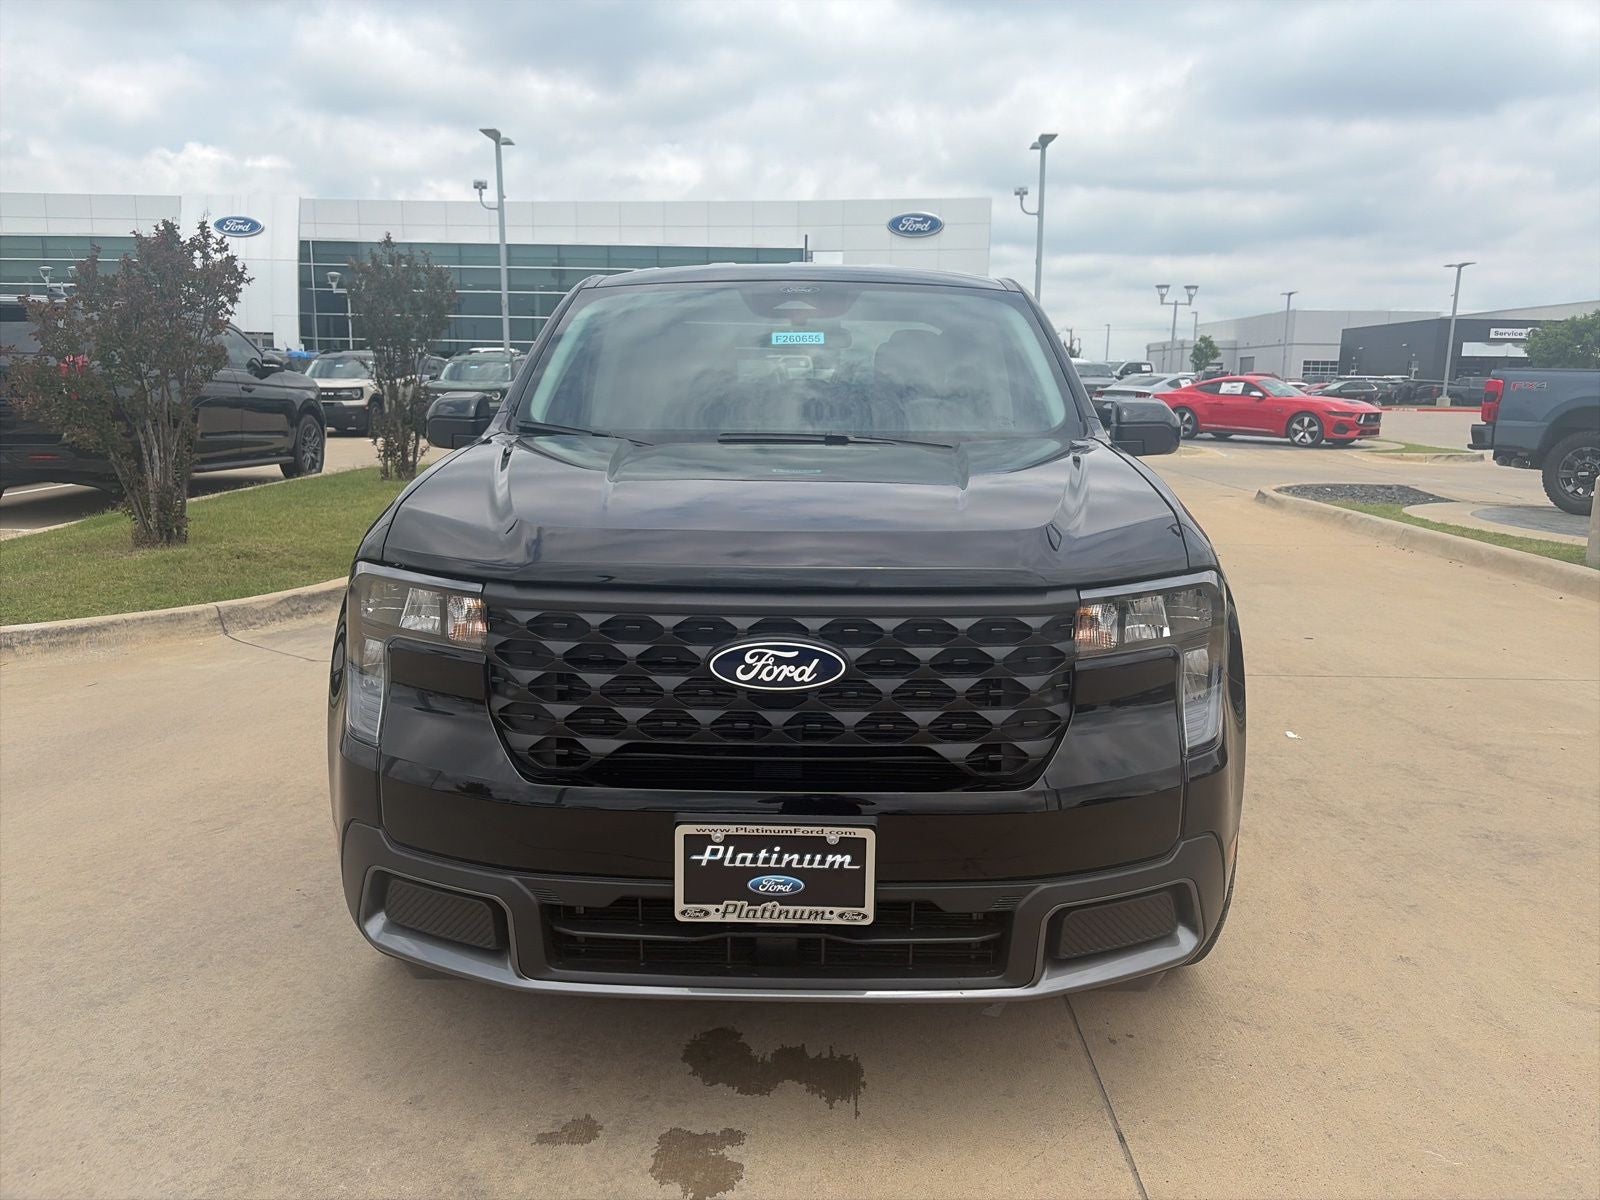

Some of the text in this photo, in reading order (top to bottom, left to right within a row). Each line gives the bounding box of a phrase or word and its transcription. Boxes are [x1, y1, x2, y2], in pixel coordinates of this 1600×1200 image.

[223, 219, 251, 231] Ford
[898, 217, 931, 231] Ford
[775, 335, 821, 343] F260655
[1511, 381, 1547, 391] FX4
[736, 648, 820, 682] Ford
[695, 826, 856, 836] www.PlatinumFord.com
[690, 845, 861, 869] Platinum
[758, 877, 793, 893] Ford
[683, 901, 864, 921] Ford Platinum Ford
